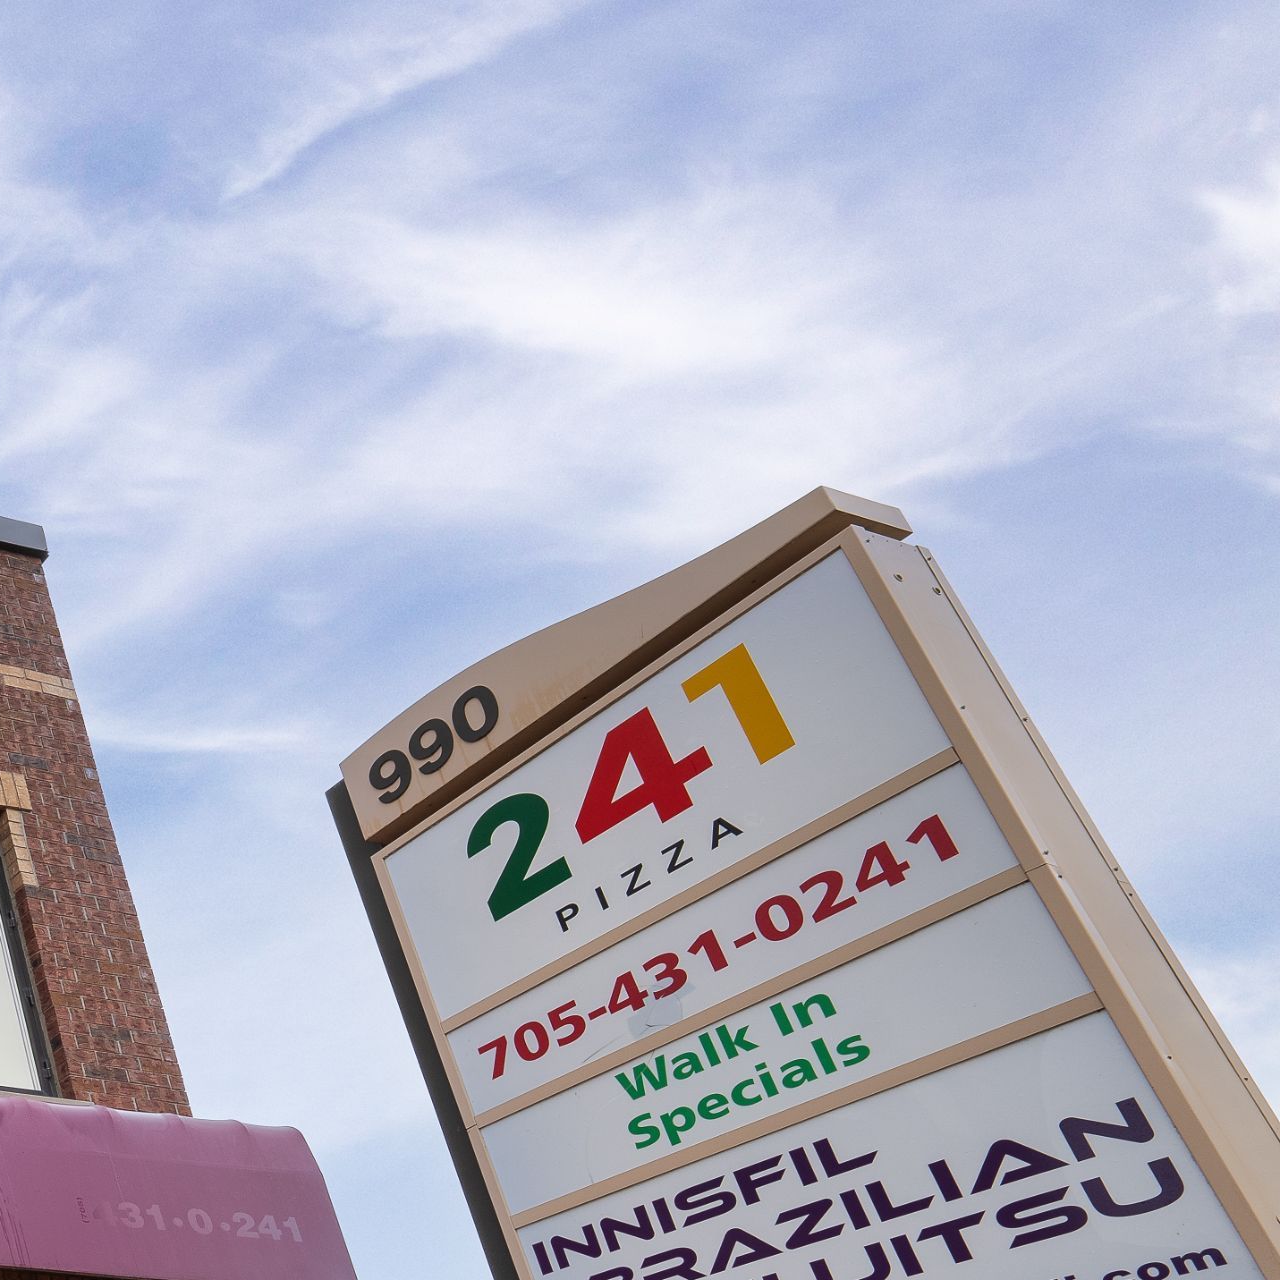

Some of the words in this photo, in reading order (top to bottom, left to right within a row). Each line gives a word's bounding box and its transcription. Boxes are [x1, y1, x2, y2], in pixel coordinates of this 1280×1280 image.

[369, 685, 500, 805] 990
[466, 642, 796, 923] 241
[556, 817, 743, 932] PIZZA
[477, 814, 961, 1080] 705-431-0241
[614, 1022, 759, 1101] Walk
[770, 988, 837, 1038] In
[627, 1033, 871, 1150] Specials
[533, 1137, 878, 1276] INNISFIL
